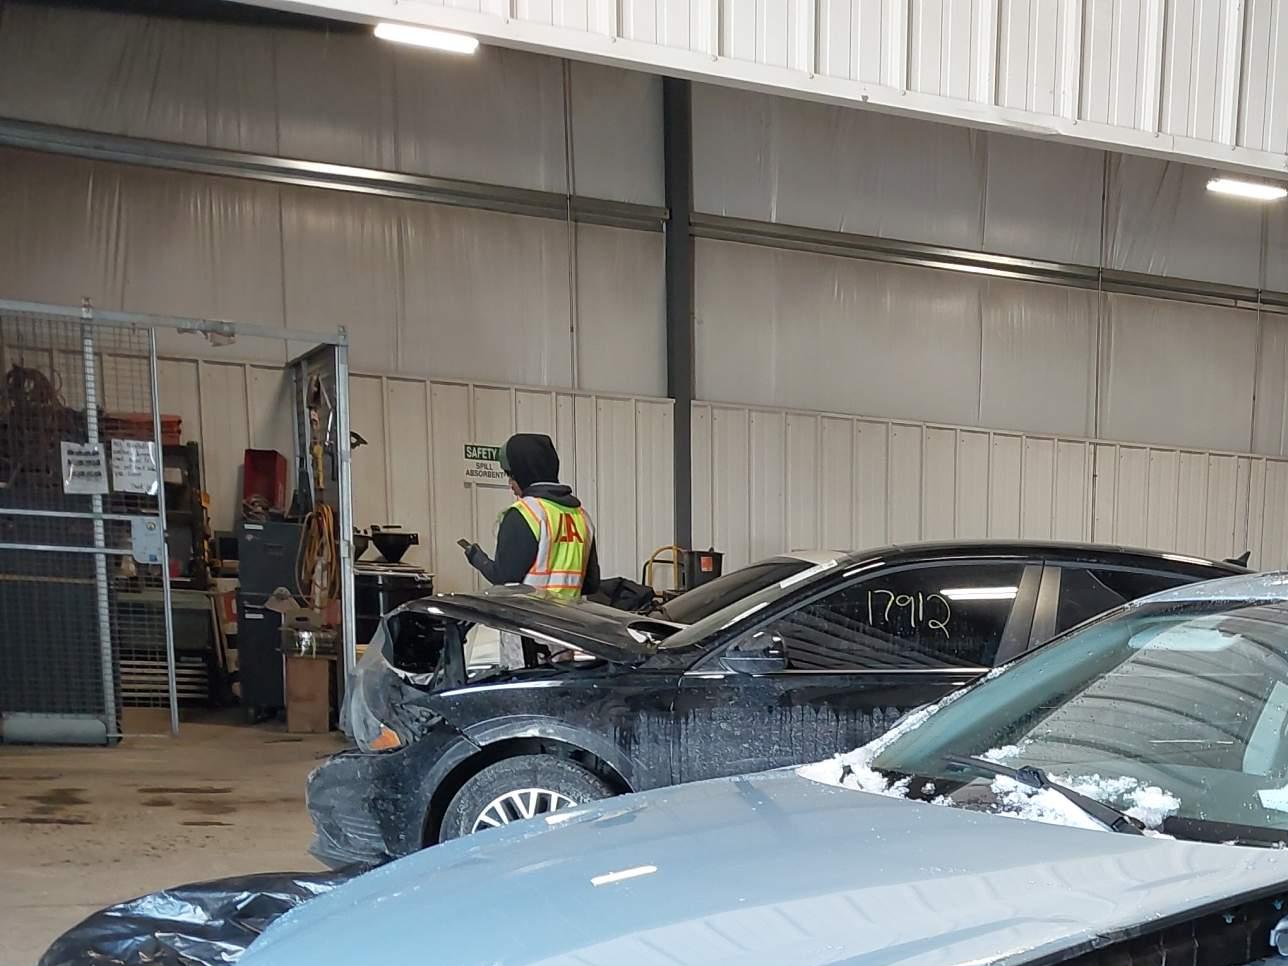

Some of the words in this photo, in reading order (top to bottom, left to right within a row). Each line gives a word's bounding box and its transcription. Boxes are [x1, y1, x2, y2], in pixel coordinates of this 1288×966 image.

[466, 446, 497, 460] SAFETY
[475, 462, 493, 470] SPILL
[867, 589, 951, 639] 17912
